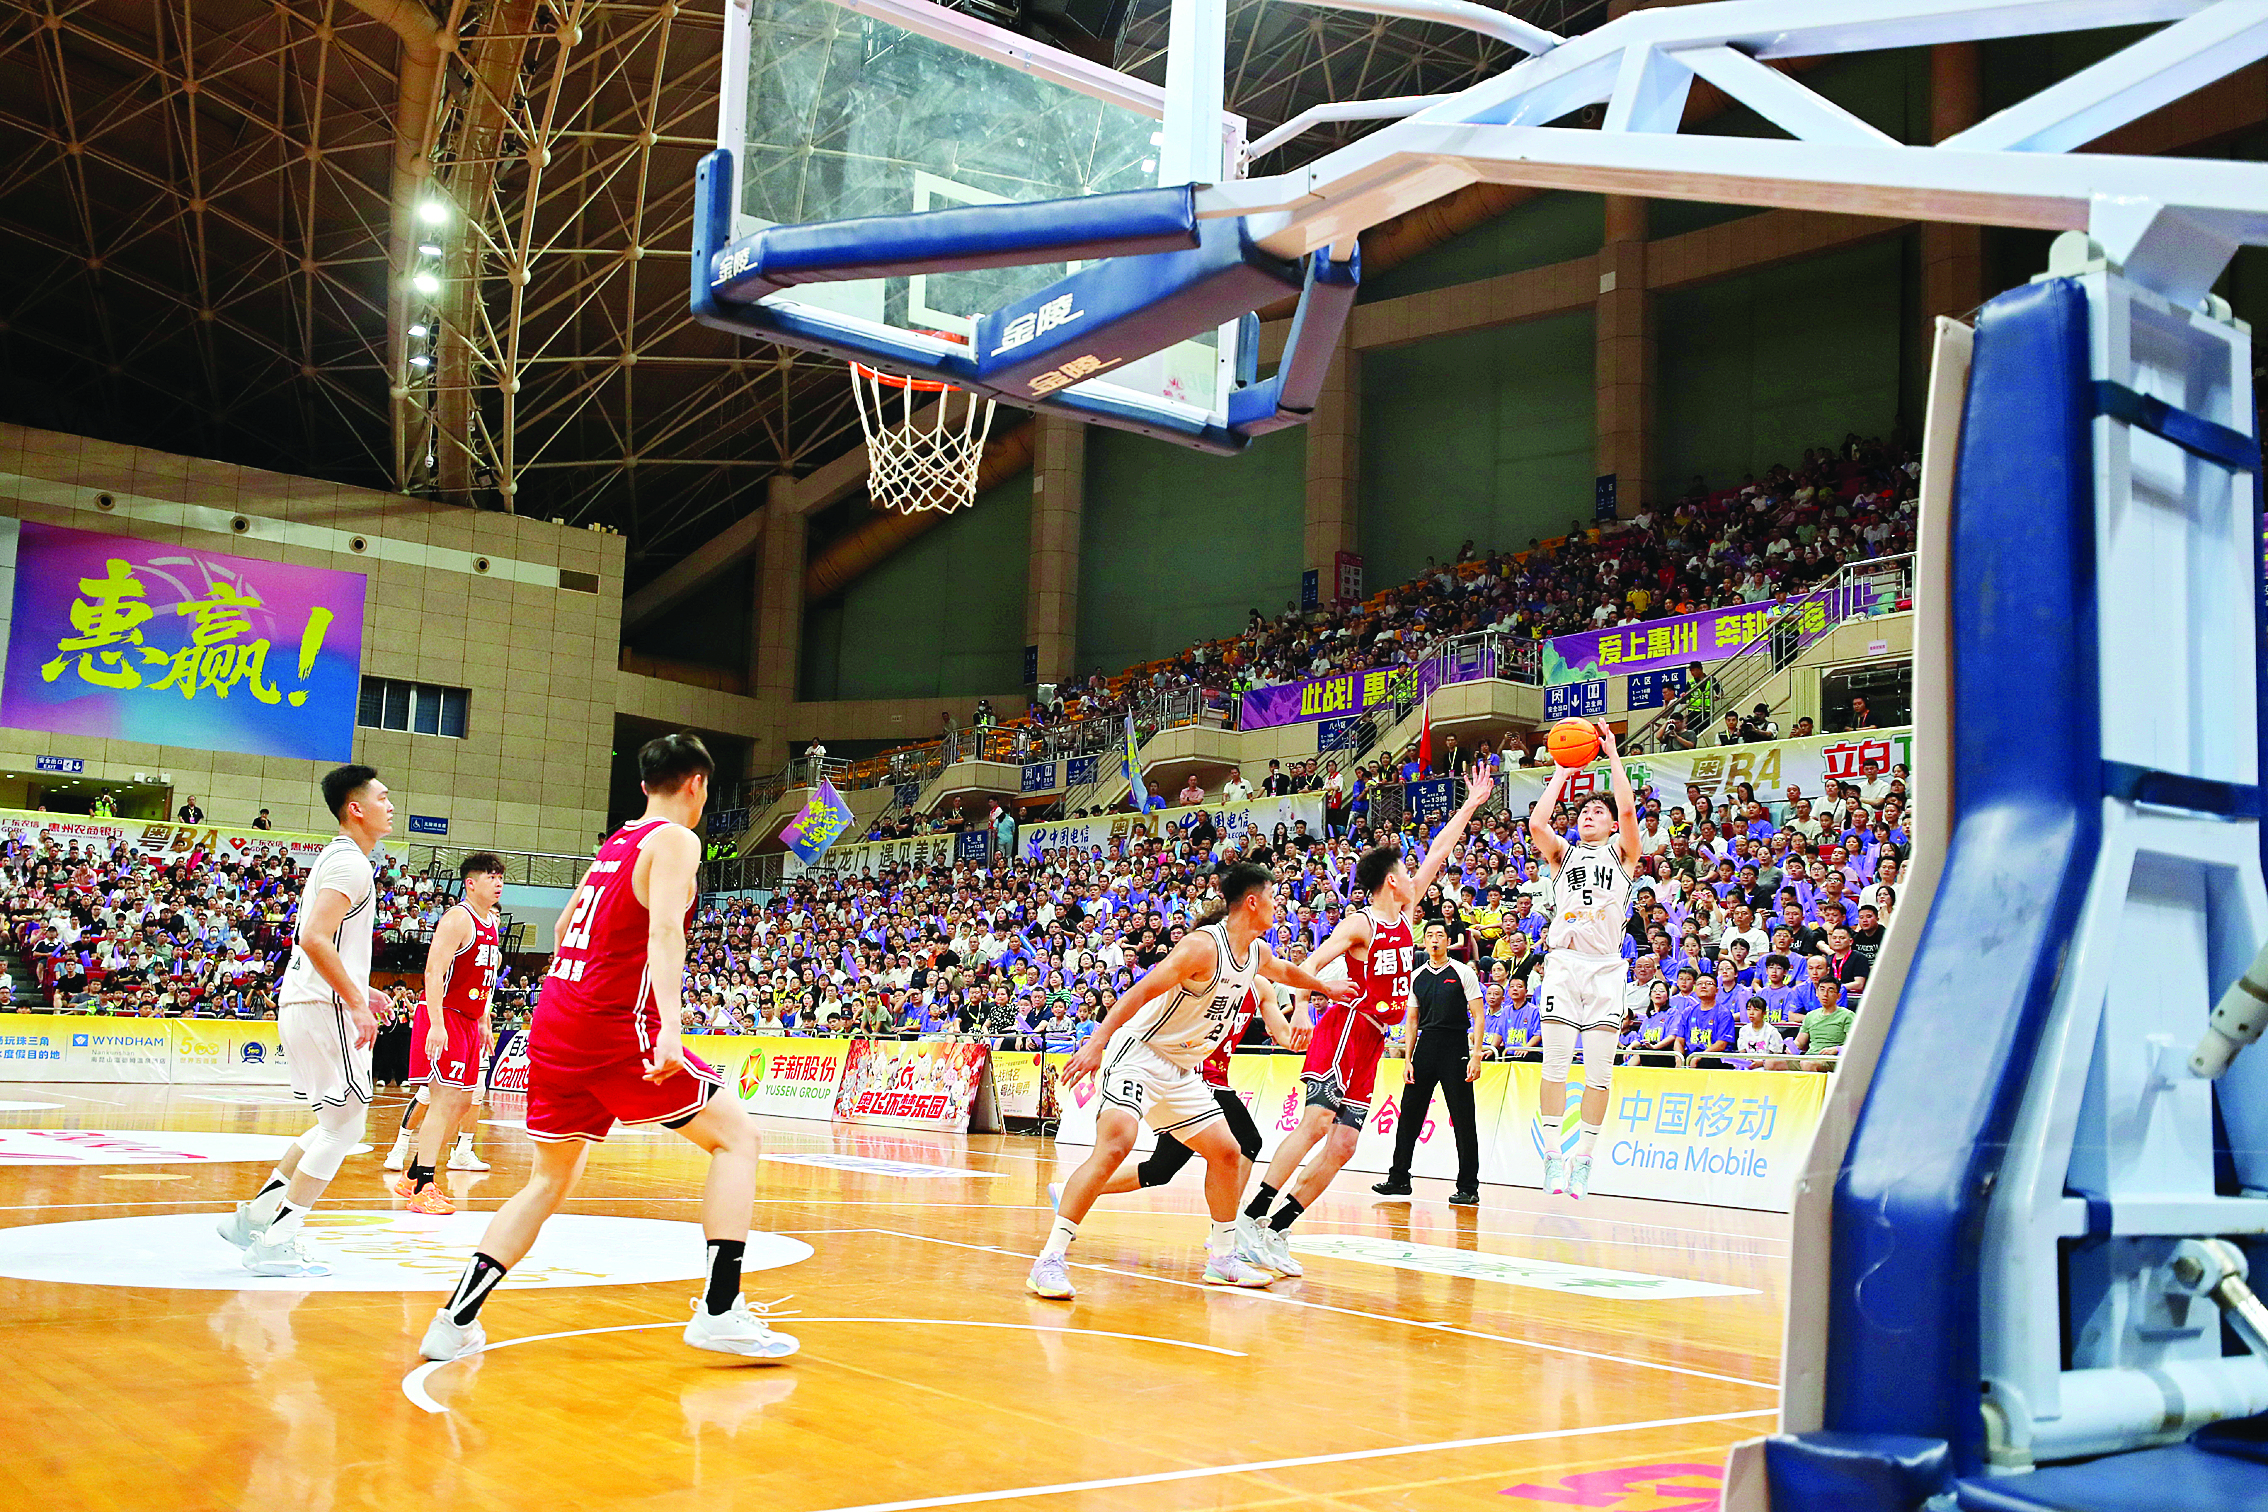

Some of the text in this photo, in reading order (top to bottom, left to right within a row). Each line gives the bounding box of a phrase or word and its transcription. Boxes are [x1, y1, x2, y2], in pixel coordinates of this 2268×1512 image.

[711, 247, 757, 287] 金陵
[991, 293, 1084, 356] 金陵
[1028, 354, 1122, 396] 金陵
[41, 558, 334, 707] 惠赢!
[1598, 601, 1825, 666] 爱上惠州 奔赴海
[1300, 667, 1418, 715] 此战! 惠!
[1632, 673, 1679, 686] 八区 九区
[1548, 705, 1567, 713] 安全出口
[1684, 748, 1781, 797] 粤BA
[48, 822, 124, 838] 惠州农商银行
[1049, 826, 1090, 844] 中国电信
[809, 847, 870, 874] 悦龙门
[1565, 864, 1613, 892] 惠州
[1583, 889, 1593, 905] 5
[560, 884, 606, 950] 21
[1392, 976, 1409, 996] 13
[1545, 995, 1554, 1012] 5
[92, 1036, 164, 1046] WYNDHAM
[449, 1060, 466, 1079] 77
[771, 1055, 837, 1083] 宇新股份
[765, 1084, 831, 1099] YUSSEN GROUP
[1123, 1079, 1143, 1103] 22
[1618, 1089, 1778, 1141] 中国移动
[1612, 1140, 1768, 1178] China Mobile
